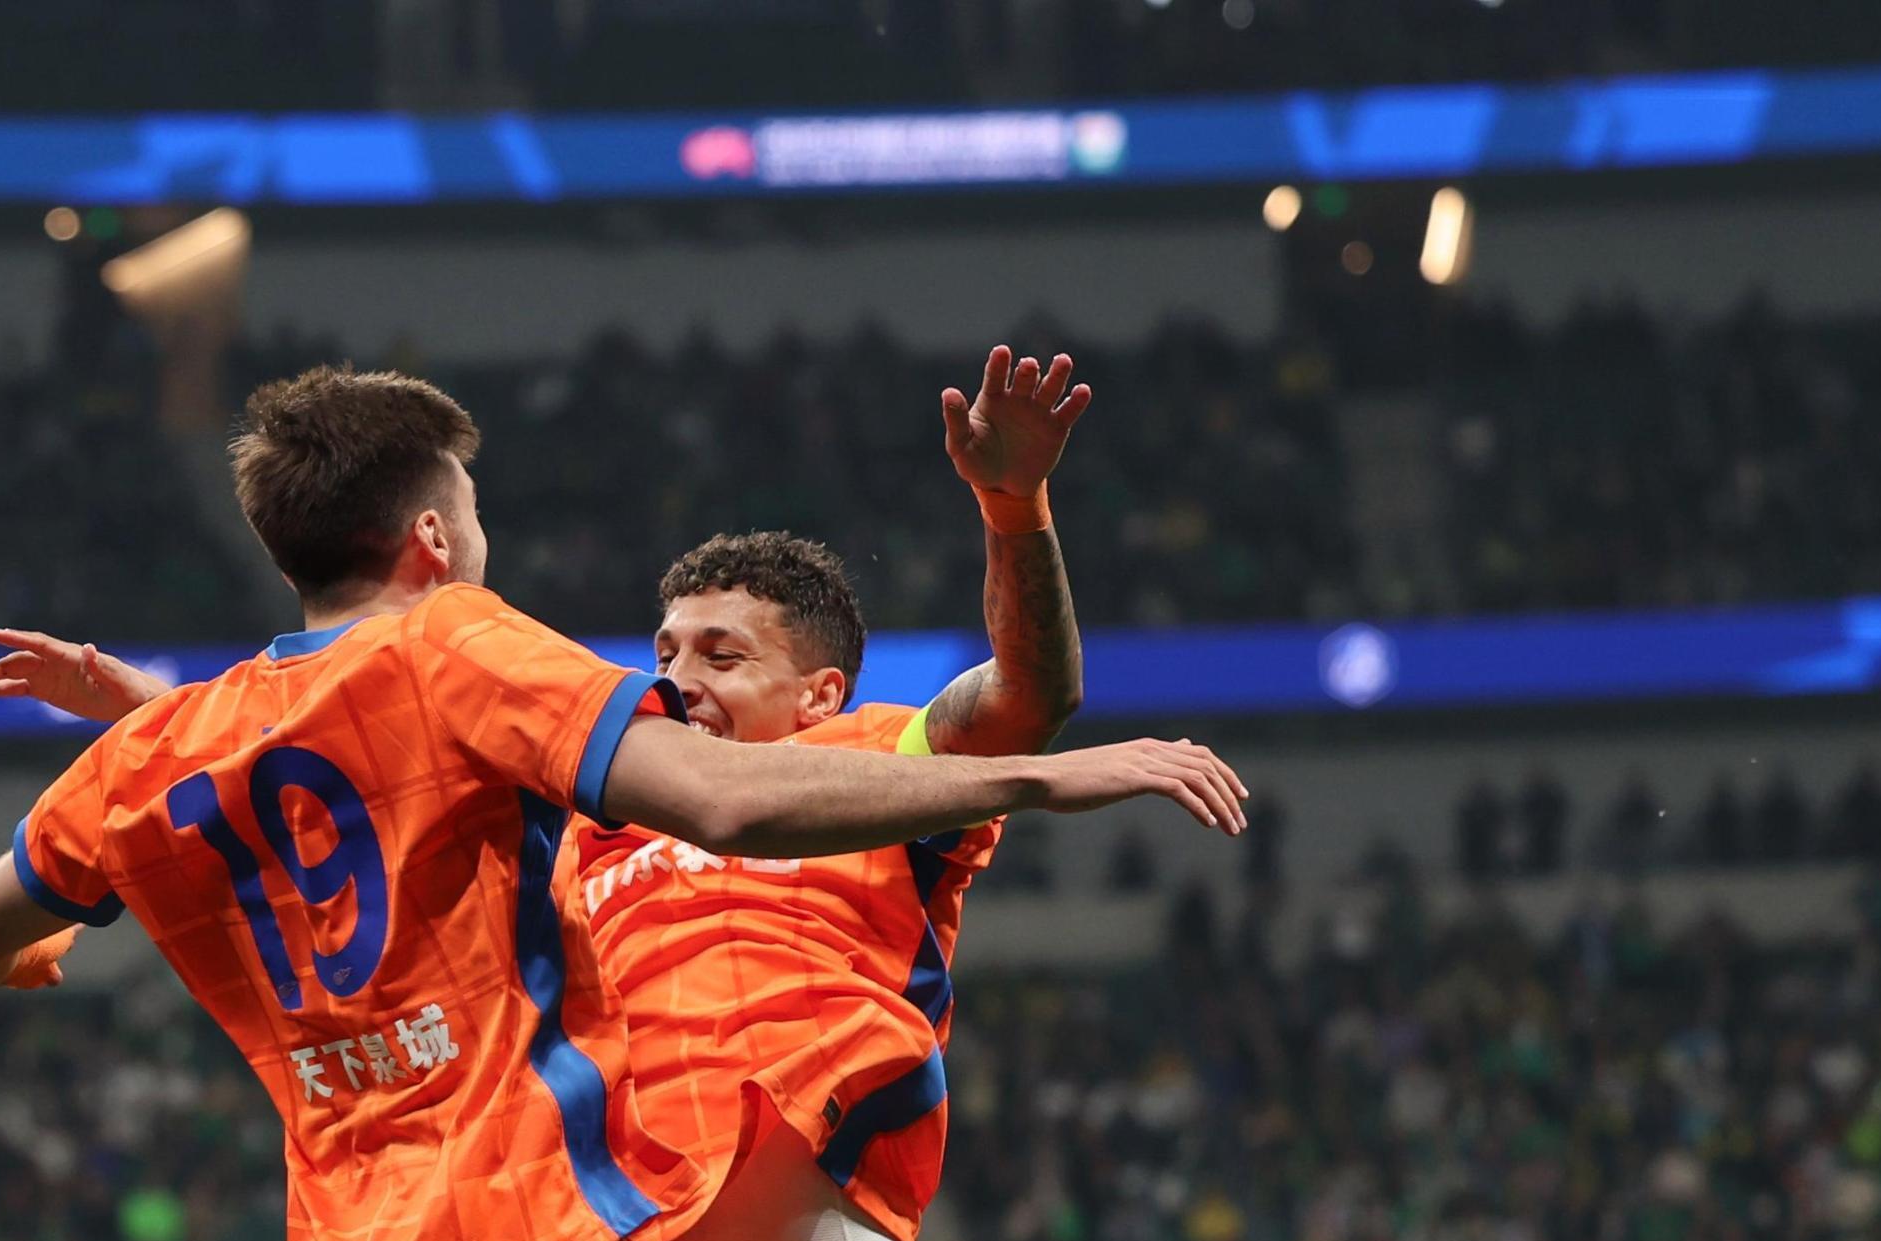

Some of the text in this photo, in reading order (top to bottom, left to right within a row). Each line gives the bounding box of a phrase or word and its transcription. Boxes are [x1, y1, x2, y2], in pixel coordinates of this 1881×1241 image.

[166, 746, 390, 1012] 19
[289, 1003, 460, 1102] 天下泉城
